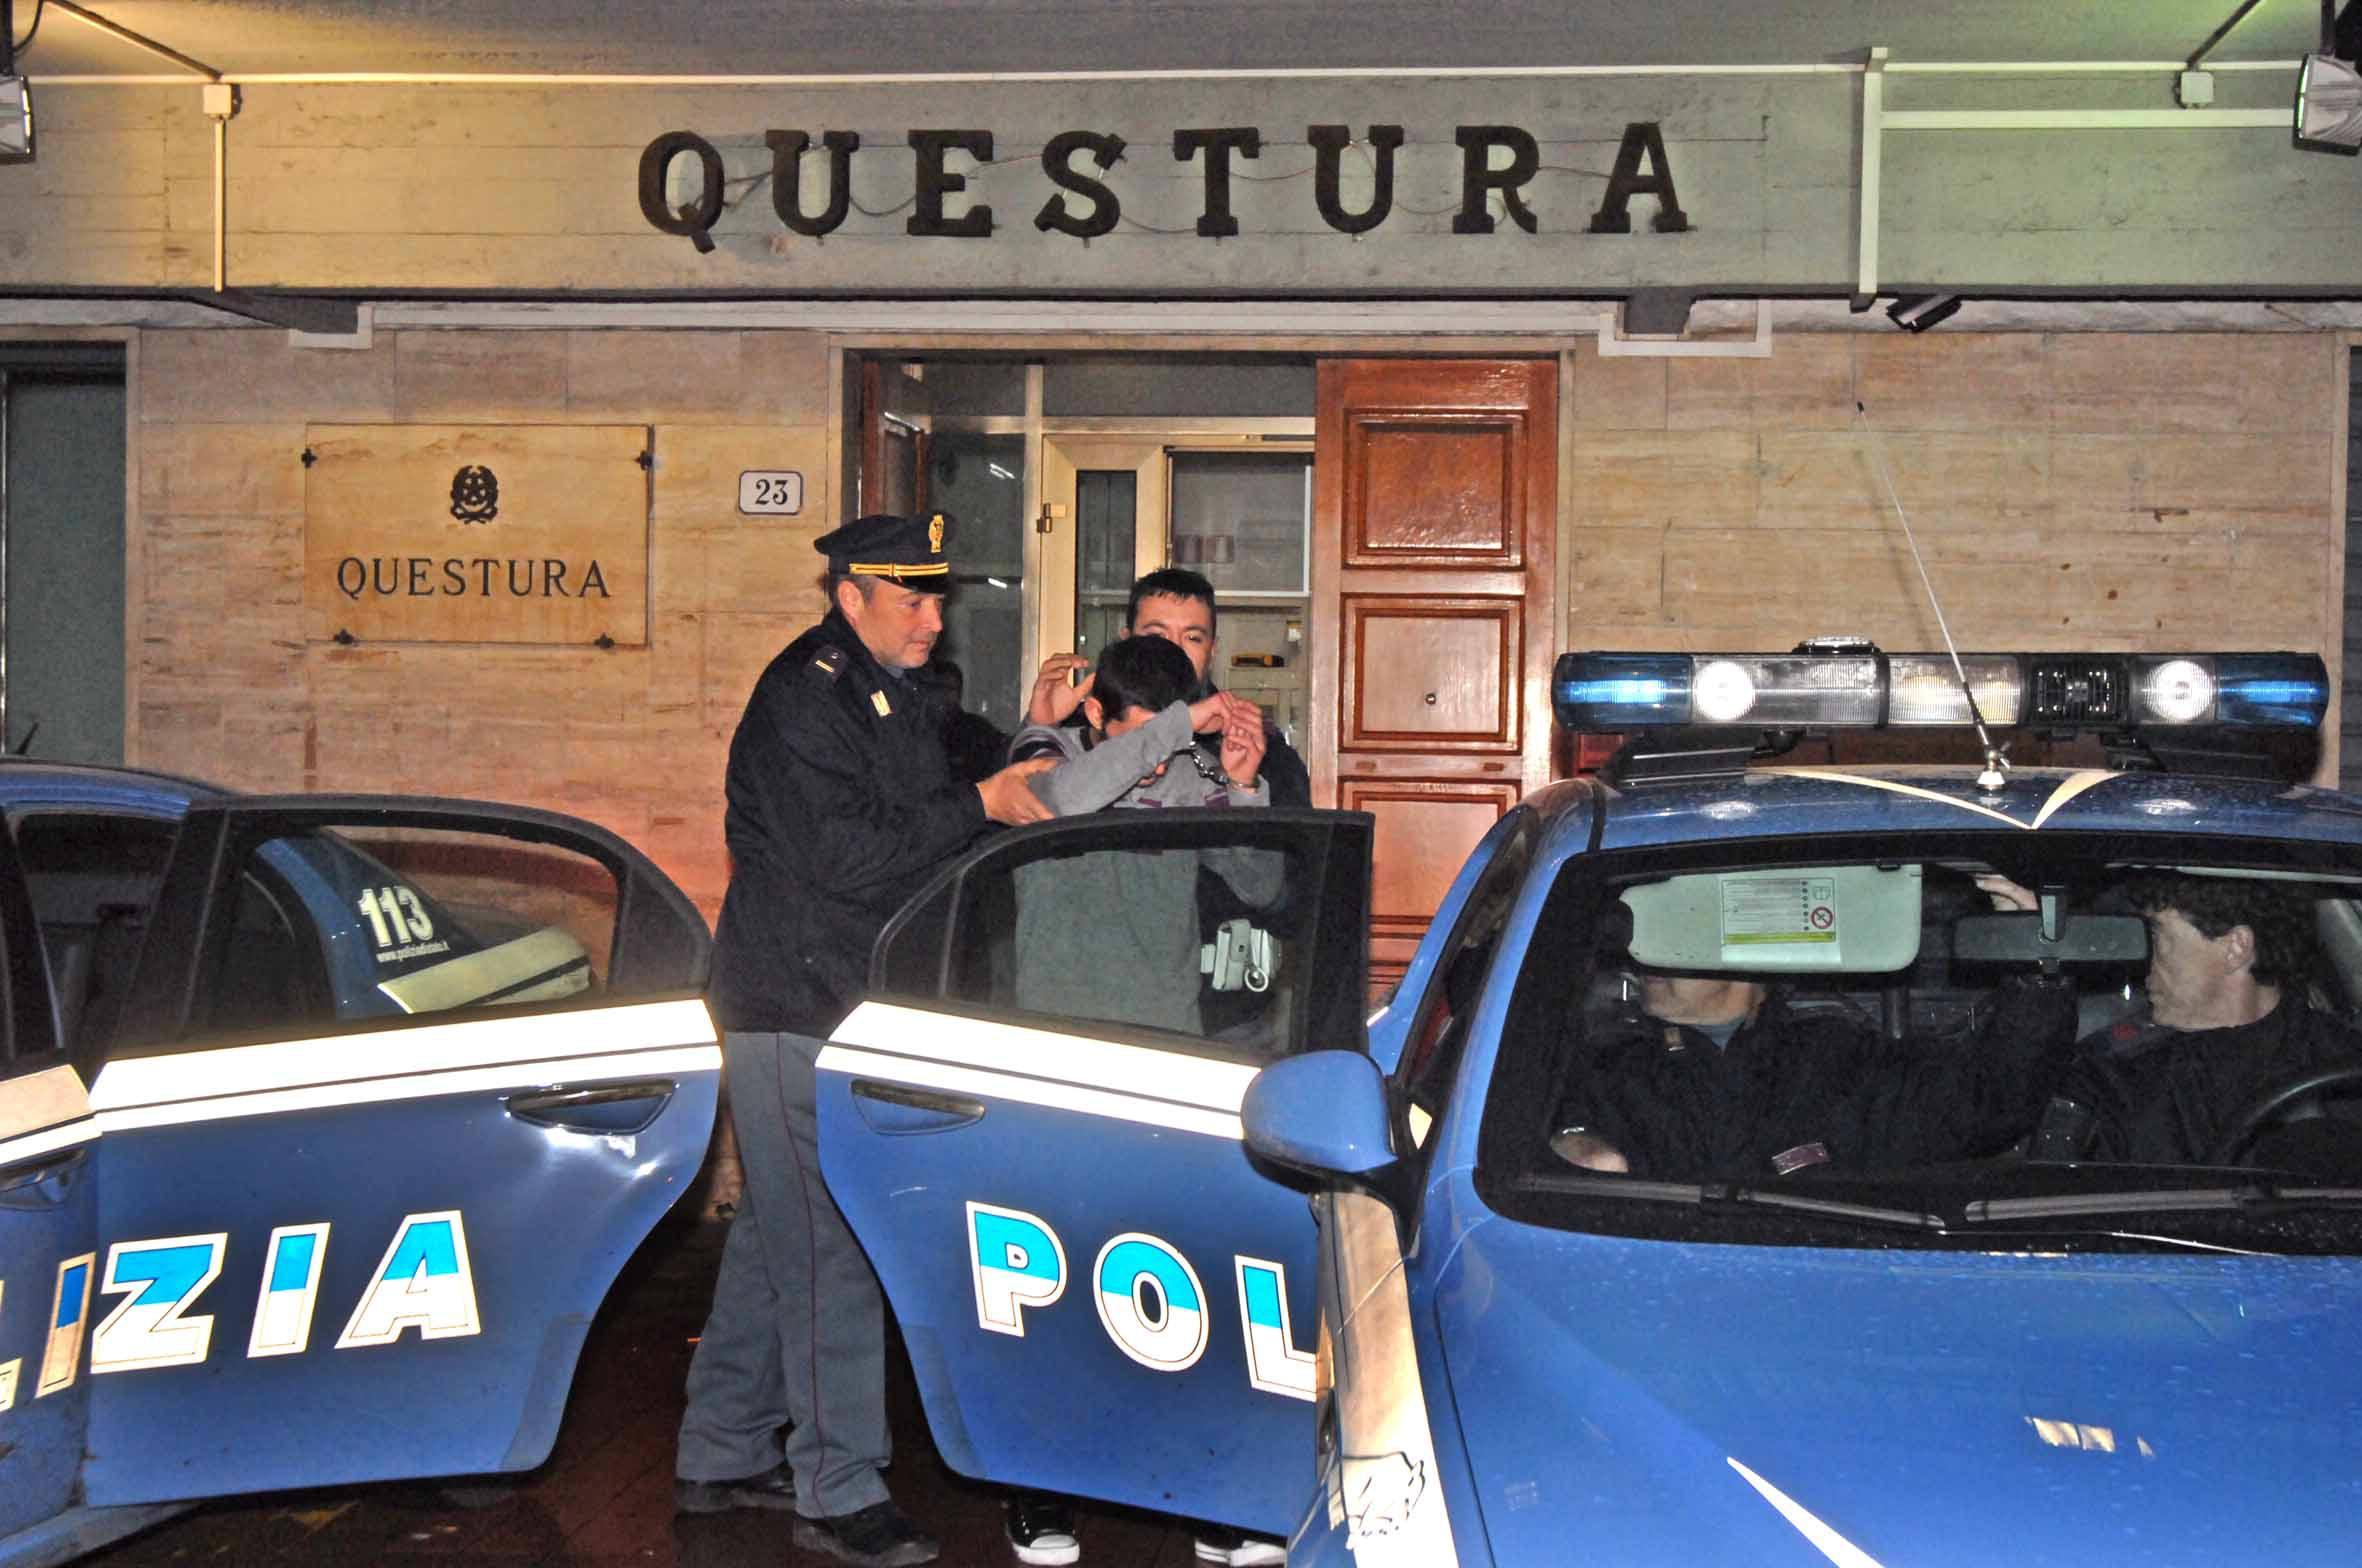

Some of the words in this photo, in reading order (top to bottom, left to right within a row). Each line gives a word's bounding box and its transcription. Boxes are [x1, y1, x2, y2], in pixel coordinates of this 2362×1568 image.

[638, 122, 1693, 253] QUESTURA
[754, 478, 790, 506] 23
[337, 556, 612, 600] QUESTURA
[357, 885, 434, 948] 113
[0, 1209, 482, 1412] IZIA
